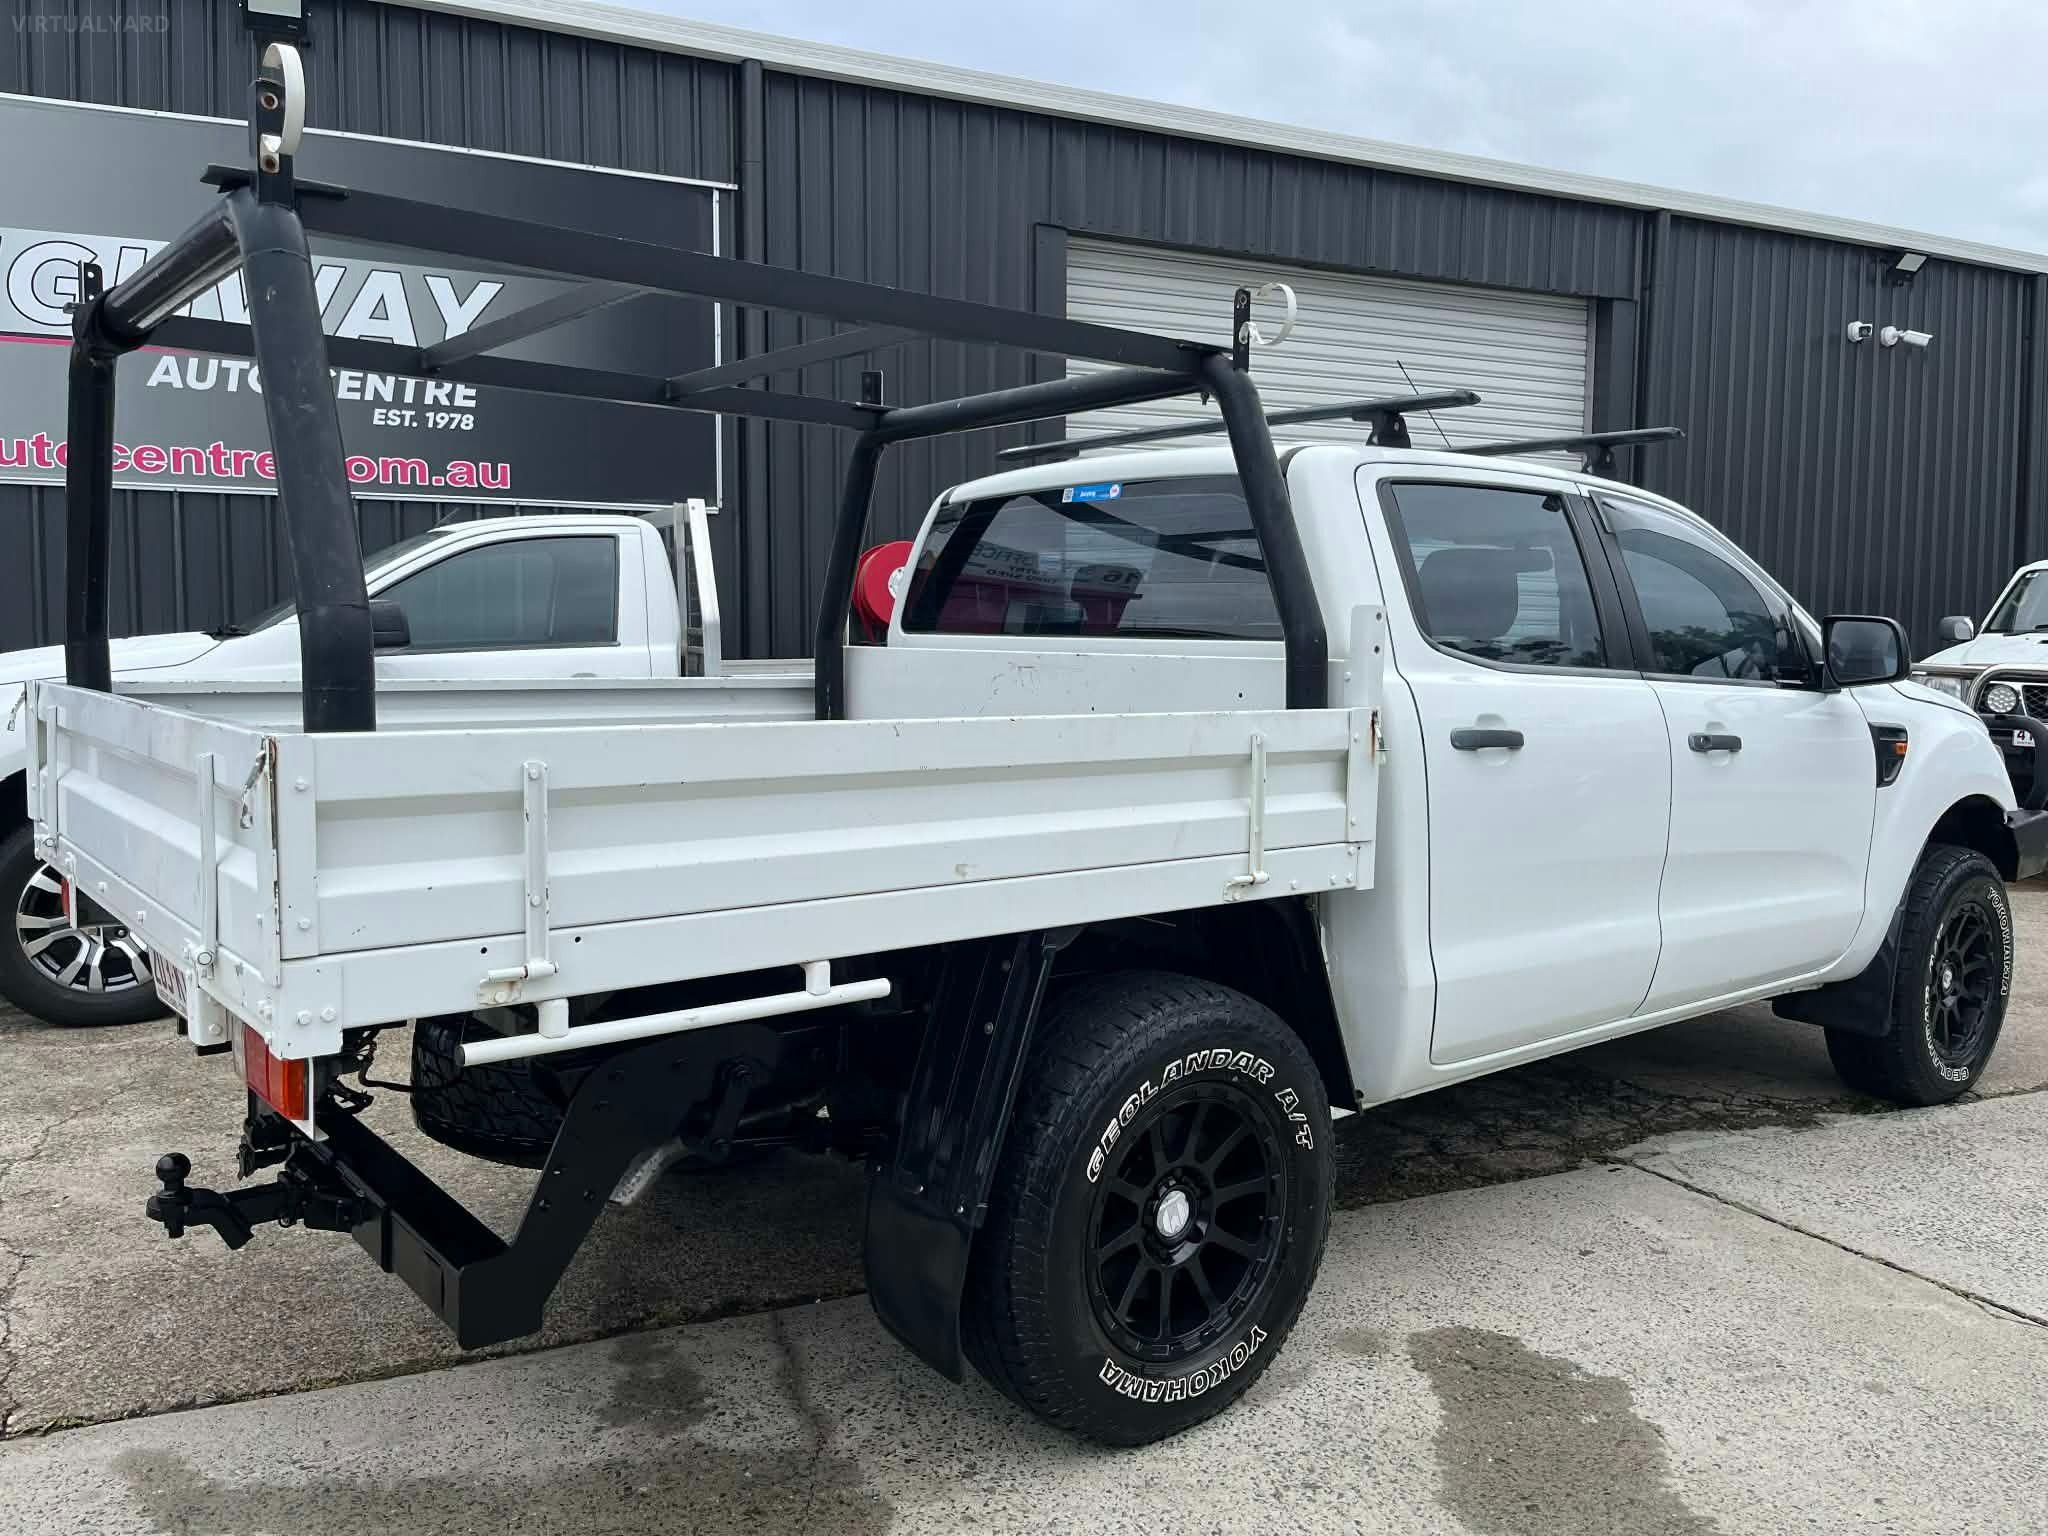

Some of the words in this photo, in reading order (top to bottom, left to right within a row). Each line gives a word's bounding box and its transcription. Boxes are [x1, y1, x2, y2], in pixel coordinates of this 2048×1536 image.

[328, 368, 478, 408] ENTRE
[372, 407, 418, 428] EST.
[425, 411, 475, 431] 1978
[1086, 1048, 1275, 1183] GEOLANDAR
[1099, 1325, 1268, 1403] YOKOHAMA
